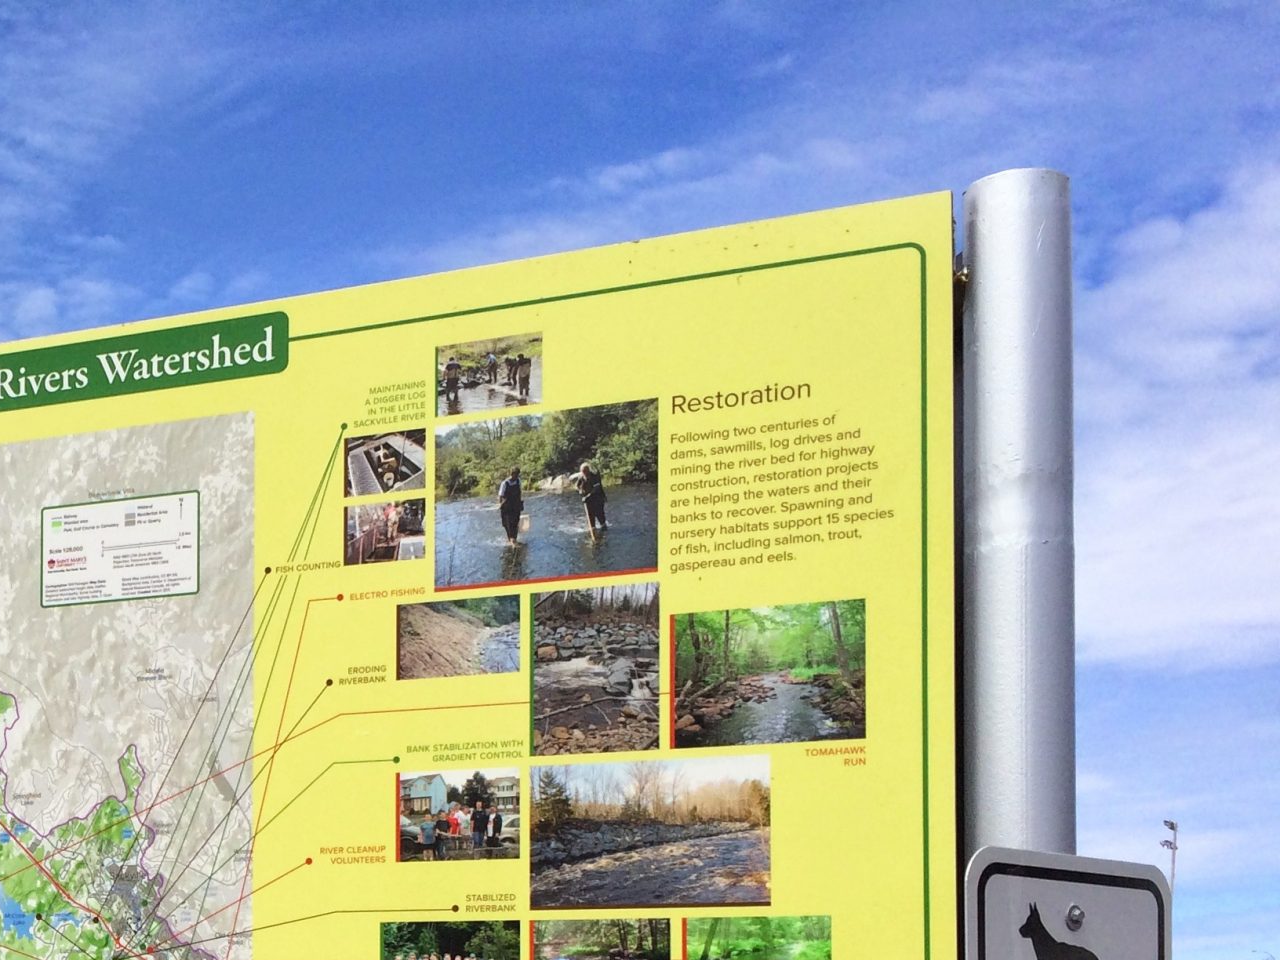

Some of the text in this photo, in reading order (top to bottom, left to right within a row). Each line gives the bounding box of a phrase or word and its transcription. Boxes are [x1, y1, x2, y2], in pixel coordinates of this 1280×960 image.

[97, 326, 276, 383] Watershed
[369, 380, 426, 394] MAINTAINING
[373, 393, 405, 404] DIGGER
[407, 390, 426, 400] LOG
[672, 383, 810, 414] Restoration
[379, 404, 396, 413] THE
[398, 401, 425, 411] LITTLE
[353, 411, 426, 428] SACKVILLE RIVER
[670, 414, 836, 444] Following two centuries of
[670, 427, 861, 460] dams, sawmills, log drives and
[670, 445, 875, 476] mining the river bed for highway
[670, 460, 879, 492] construction, restoration projects
[670, 477, 872, 508] are helping the waters and their
[670, 492, 872, 523] banks to recover. Spawning and
[670, 508, 894, 539] nursery habitats support 15 species
[670, 528, 862, 555] of fish, including salmon, trout,
[275, 560, 341, 573] FISH COUNTING
[670, 551, 796, 574] gaspereau and eels.
[349, 586, 426, 600] ELECTRO FISHING
[347, 665, 387, 674] ERODING
[338, 675, 386, 685] RIVERBANK
[406, 739, 523, 753] BANK STABILIZATION WITH
[805, 746, 866, 756] TOMAHAWK
[432, 750, 523, 762] GRADIENT CONTROL
[843, 757, 866, 766] RUN
[320, 845, 386, 854] RIVER CLEANUP
[330, 855, 386, 864] VOLUNTEERS
[465, 893, 516, 902] STABILIZED
[465, 904, 516, 912] RIVERBANK
